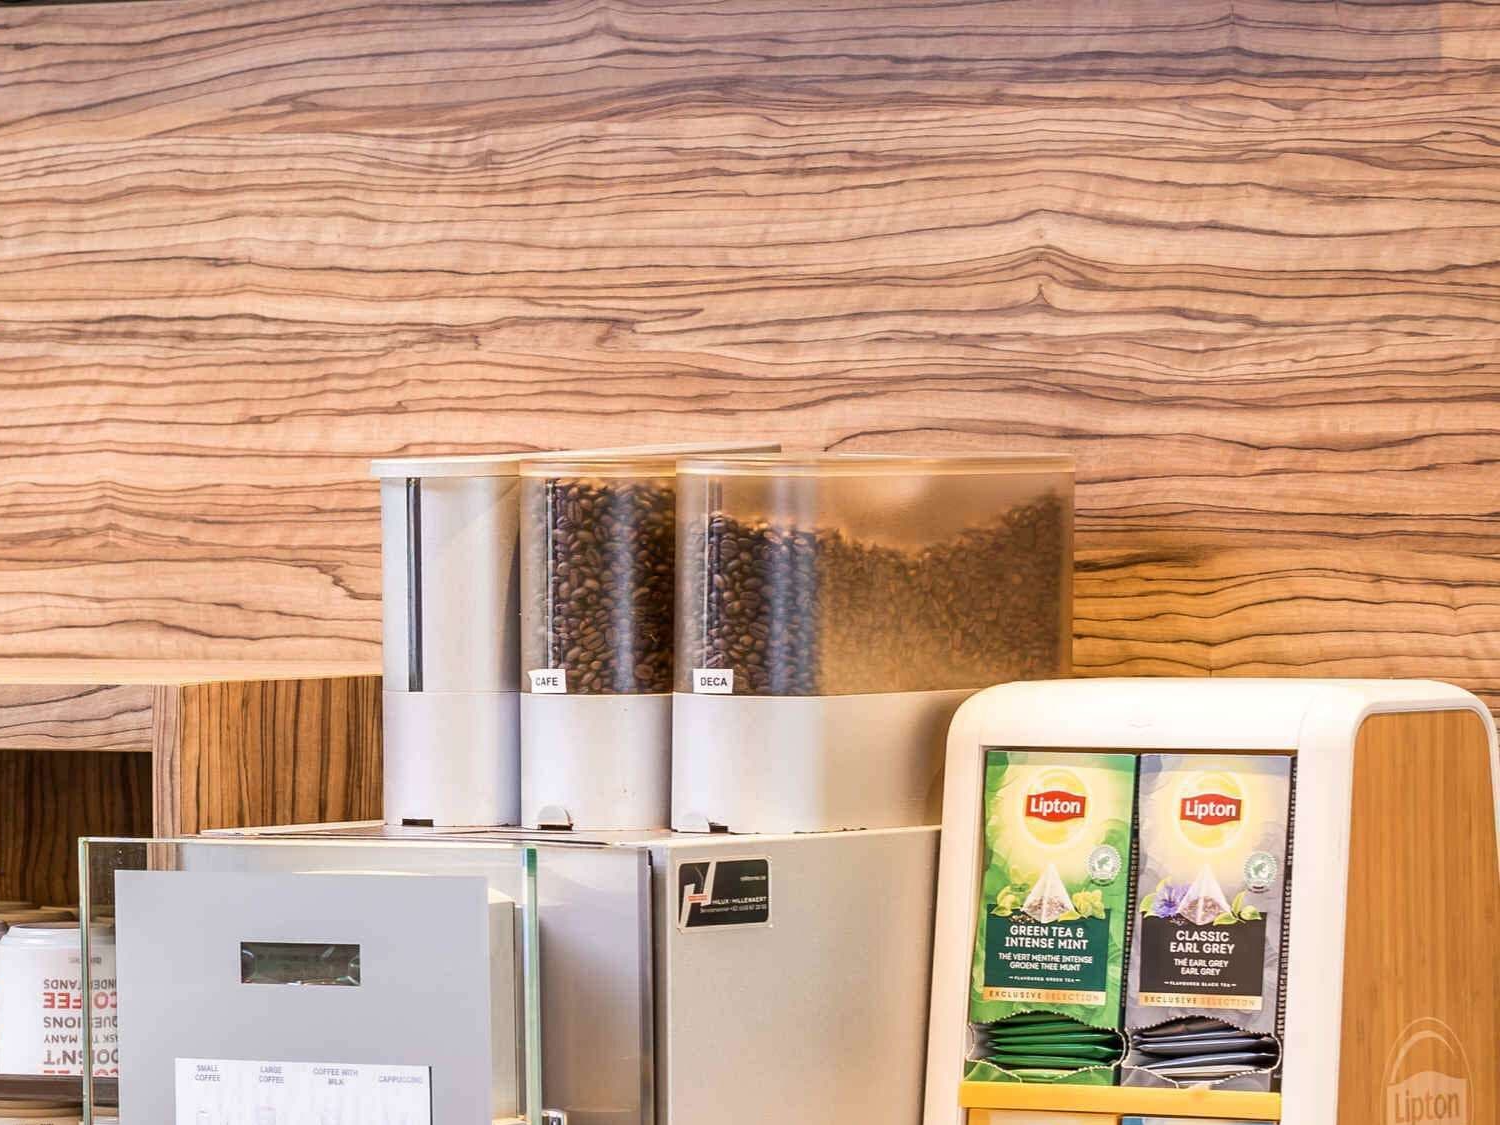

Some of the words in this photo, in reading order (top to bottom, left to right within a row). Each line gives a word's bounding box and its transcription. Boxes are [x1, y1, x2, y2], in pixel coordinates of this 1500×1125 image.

[536, 677, 559, 687] CAFE
[700, 677, 728, 687] DECA
[1029, 796, 1081, 816] Lipton
[1185, 799, 1237, 819] Lipton
[1010, 925, 1048, 936] GREEN
[1052, 926, 1073, 937] TEA
[1076, 927, 1084, 938] &
[1176, 930, 1229, 942] CLASSIC
[1004, 937, 1054, 948] INTENSE
[1058, 939, 1088, 950] MINT
[1170, 942, 1199, 953] EARL
[1202, 943, 1235, 955] GREY
[1187, 958, 1205, 967] EARL
[1207, 959, 1229, 968] GREY
[1181, 967, 1199, 975] EARL
[1200, 968, 1221, 976] GREY
[989, 990, 1042, 999] EXCLUSIVE
[1144, 995, 1197, 1004] EXCLUSIVE
